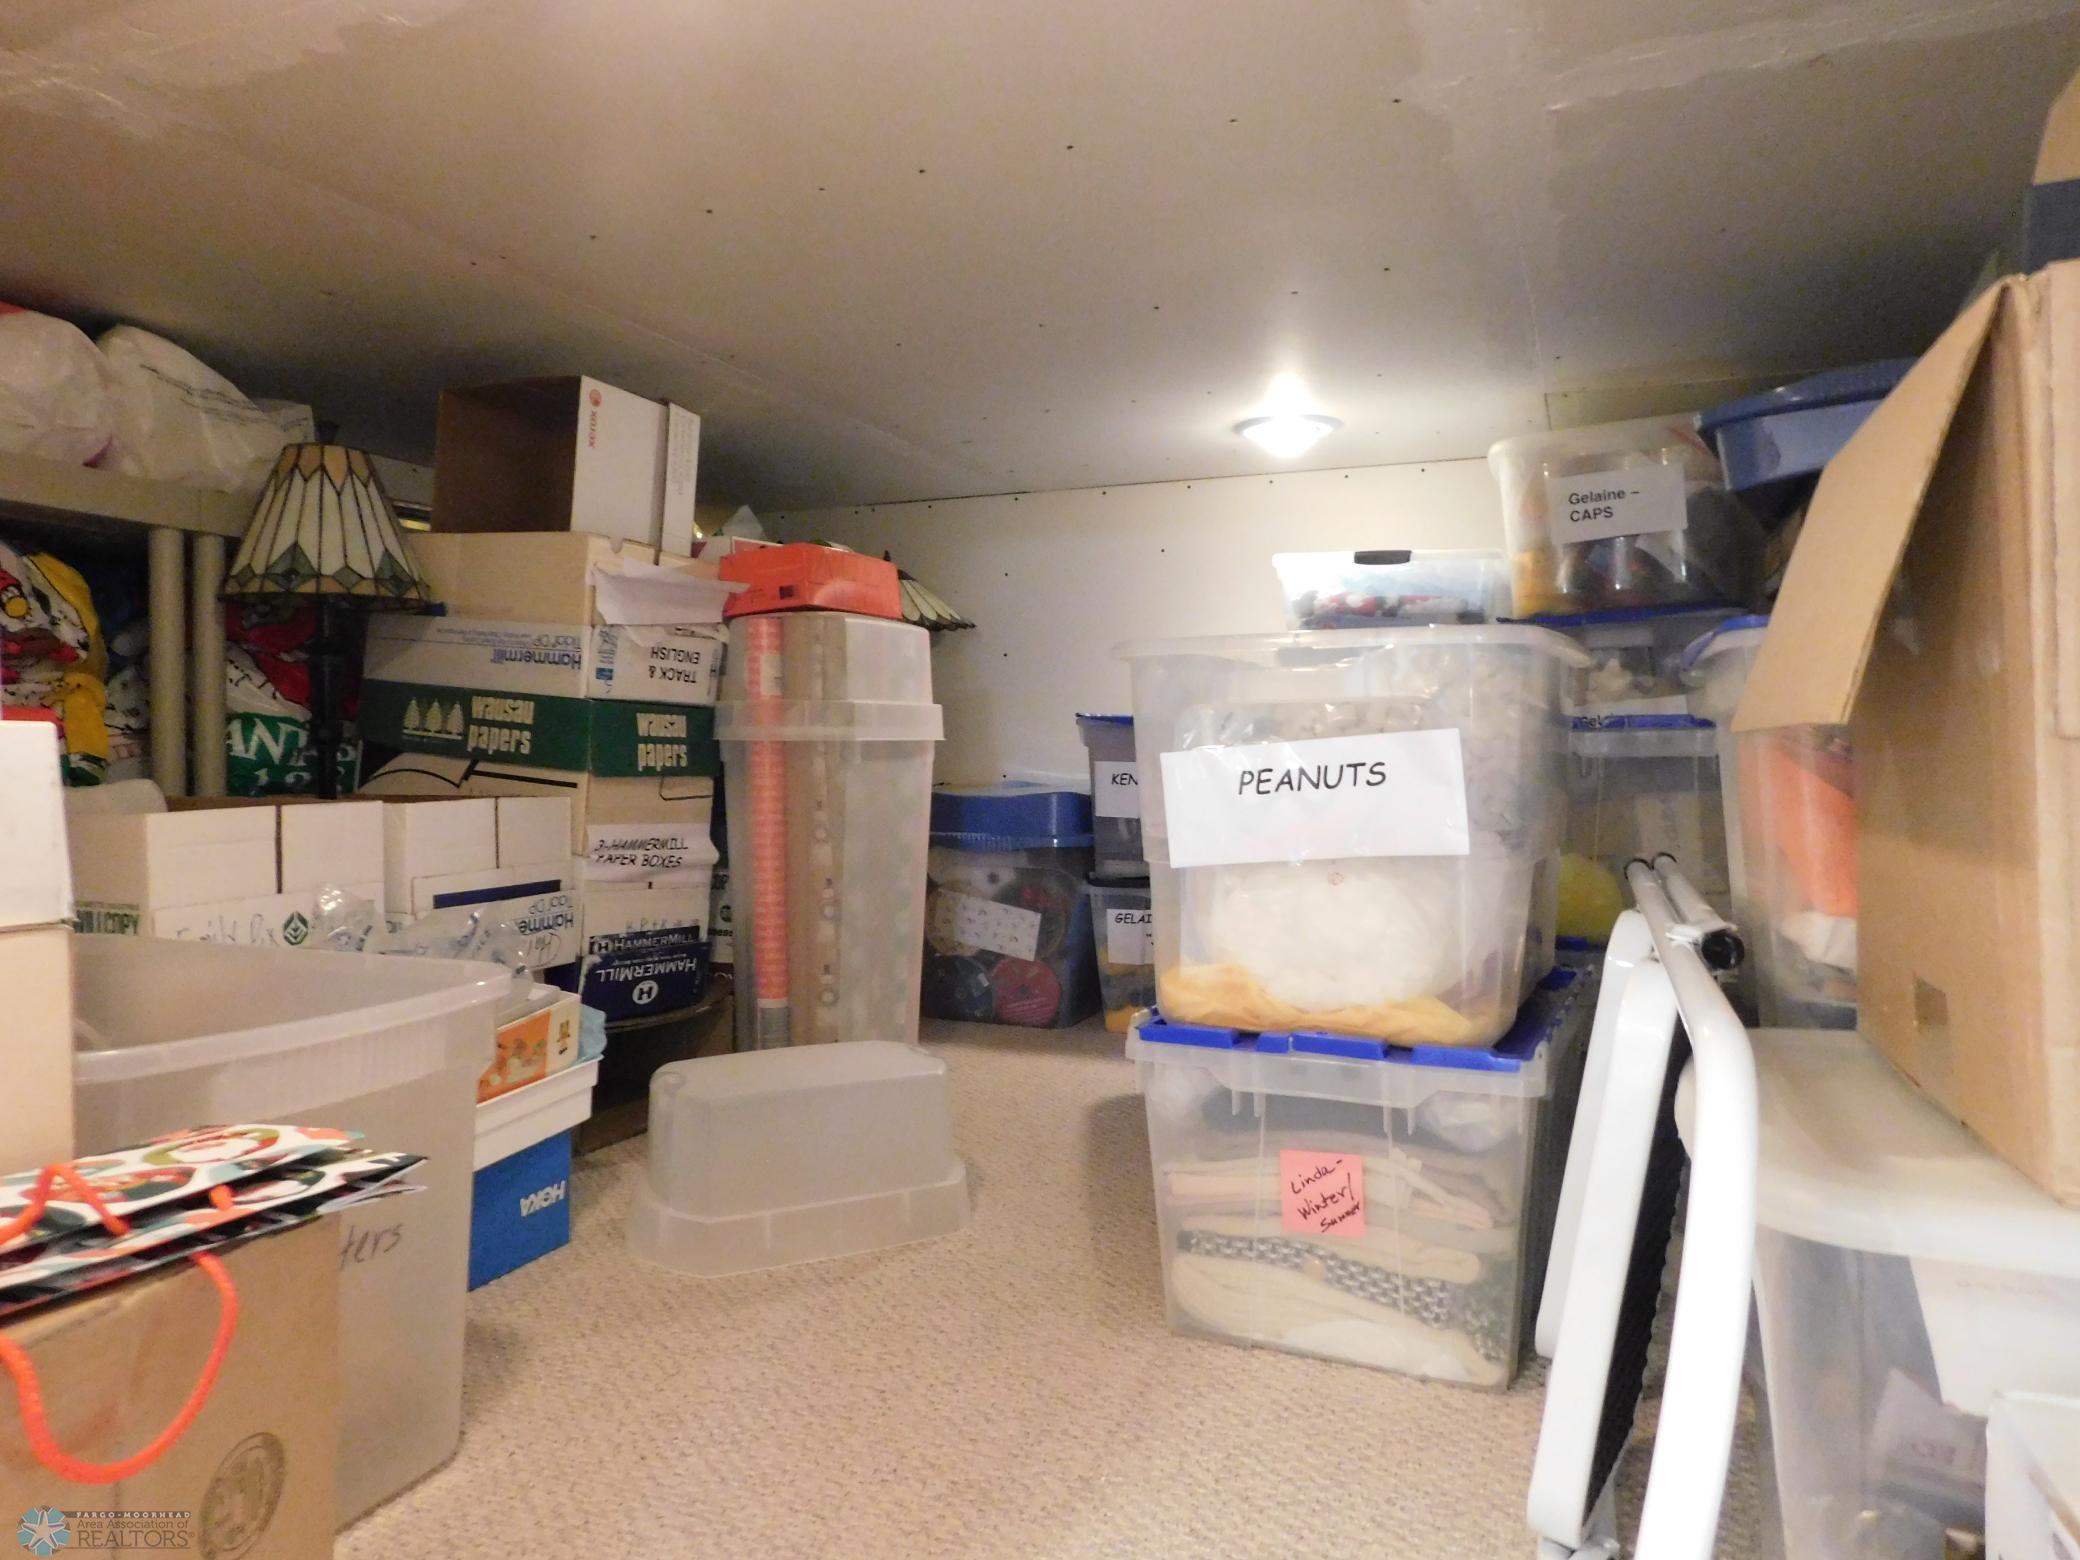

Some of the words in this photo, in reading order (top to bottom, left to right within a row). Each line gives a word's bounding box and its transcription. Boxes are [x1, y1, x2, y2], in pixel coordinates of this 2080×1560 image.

[1568, 489, 1625, 505] Gelaine
[1569, 506, 1614, 522] CAPS
[650, 647, 700, 664] ENGLISH
[649, 665, 656, 679] &
[659, 666, 697, 683] TRACK
[467, 724, 532, 755] papers
[638, 743, 688, 771] papers
[1238, 761, 1386, 795] PEANUTS
[596, 854, 637, 866] PAPER
[641, 854, 683, 868] BOXES
[1114, 912, 1152, 924] GELAI
[596, 958, 697, 982] HAMMERMILL
[1291, 1166, 1335, 1194] Linda
[519, 1180, 566, 1217] HOKA
